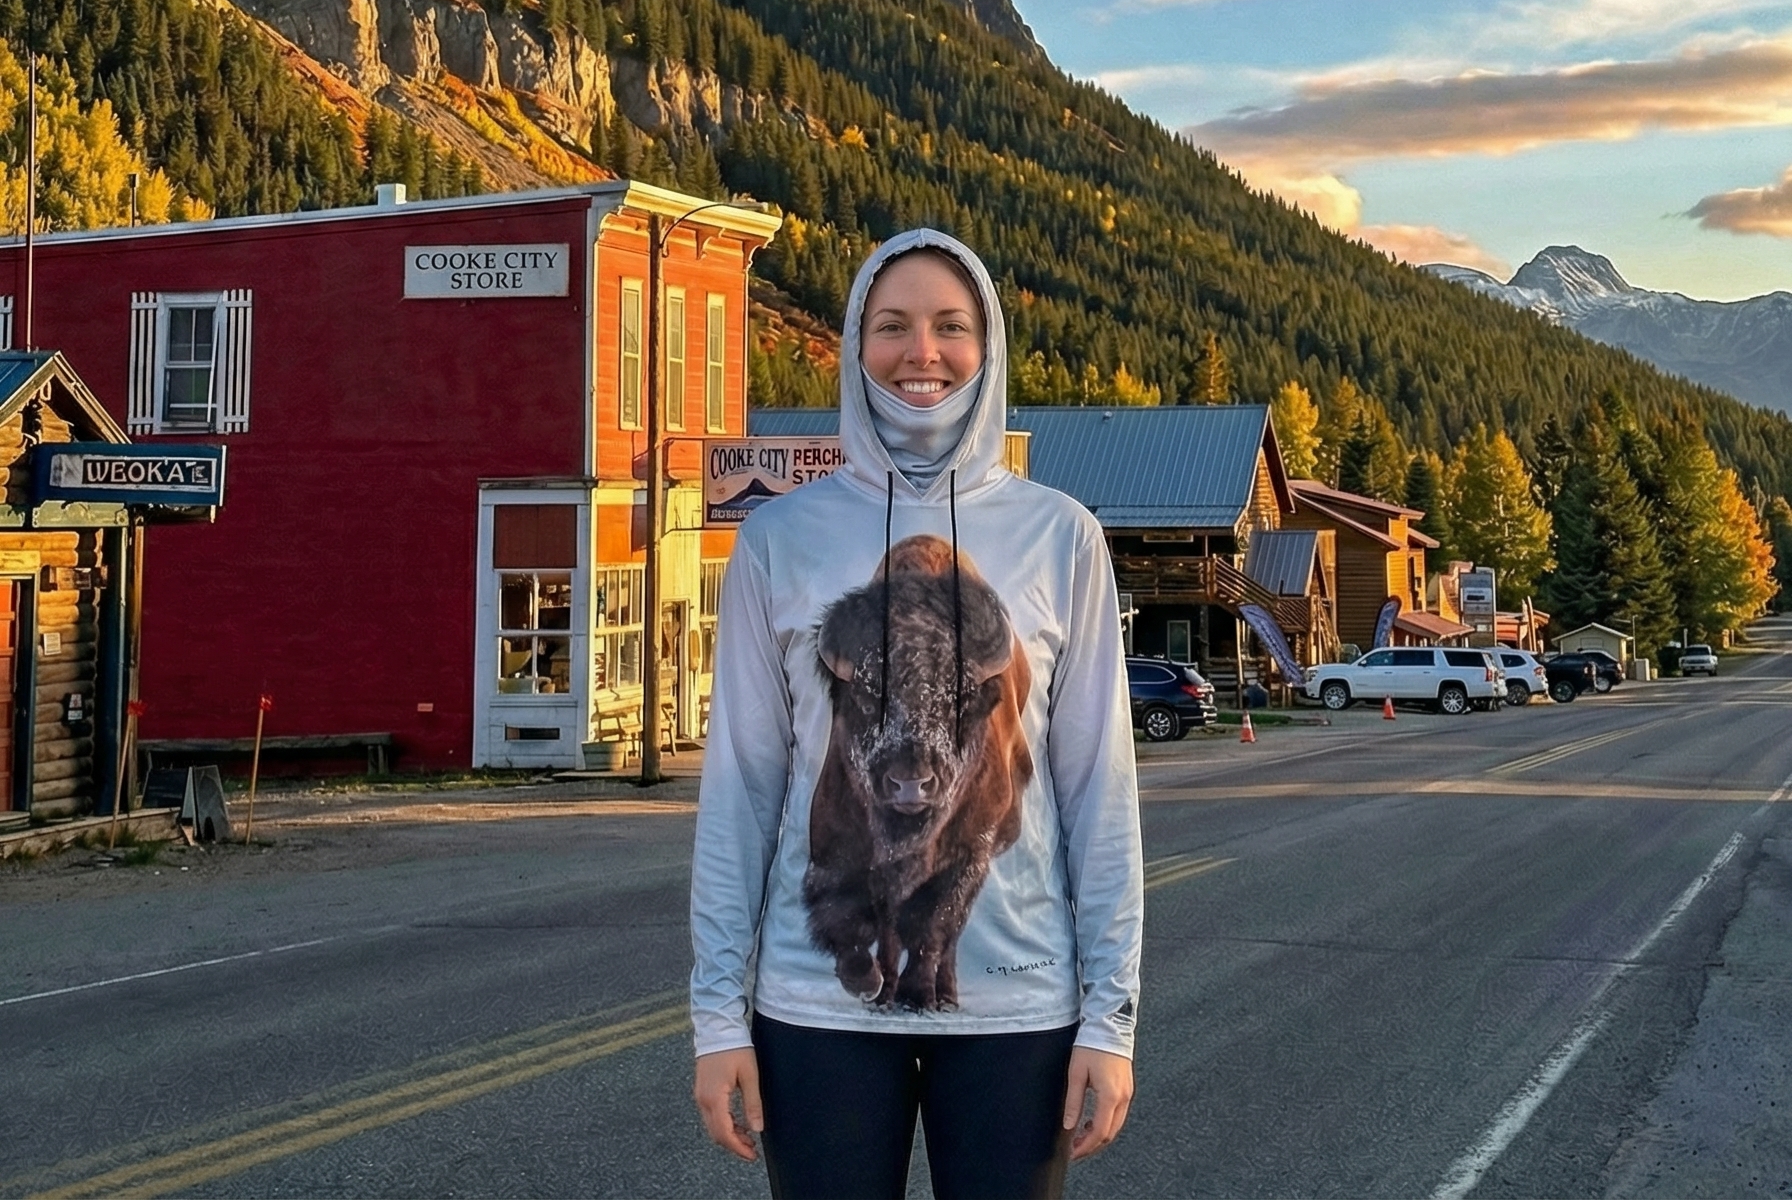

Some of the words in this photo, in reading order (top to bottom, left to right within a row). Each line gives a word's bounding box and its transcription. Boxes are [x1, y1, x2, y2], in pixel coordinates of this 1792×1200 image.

[415, 253, 496, 270] COOKE
[504, 252, 558, 269] CITY
[451, 272, 523, 289] STORE
[710, 448, 754, 480] COOKE
[759, 448, 789, 480] CITY
[793, 448, 847, 466] PERCH
